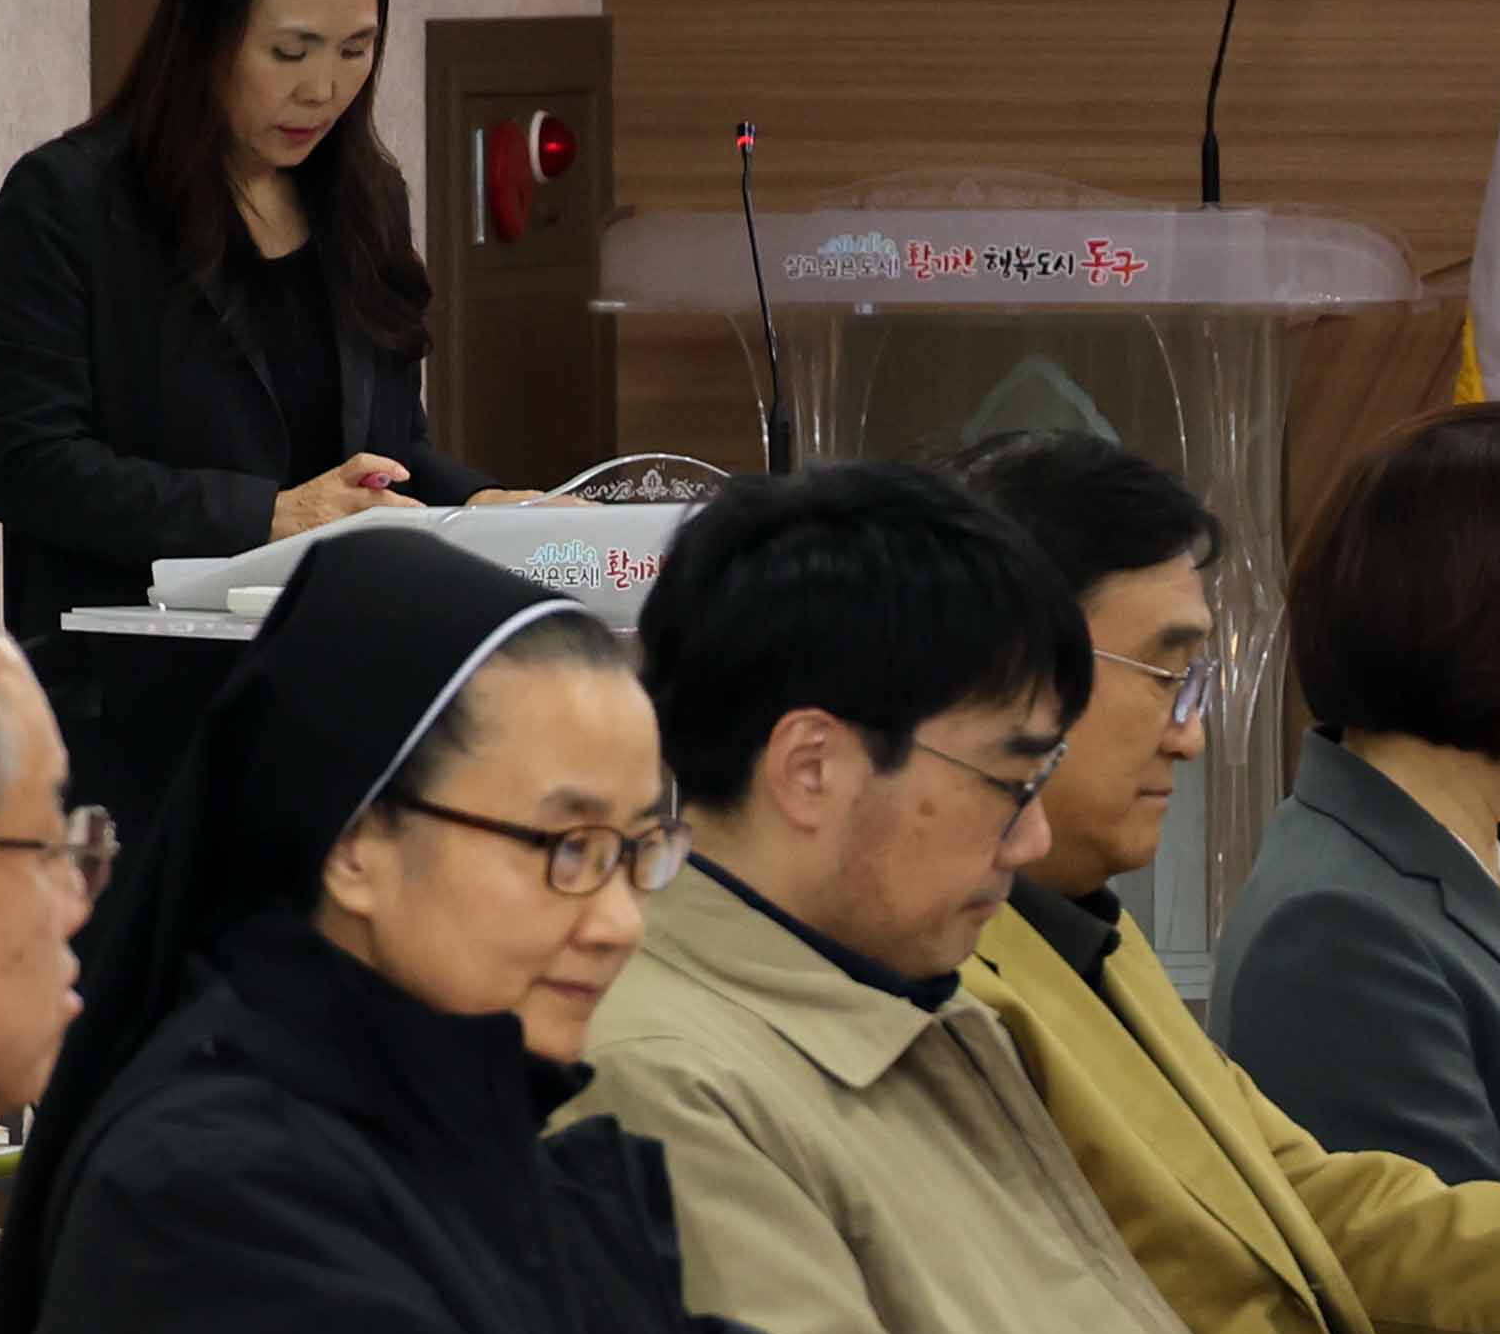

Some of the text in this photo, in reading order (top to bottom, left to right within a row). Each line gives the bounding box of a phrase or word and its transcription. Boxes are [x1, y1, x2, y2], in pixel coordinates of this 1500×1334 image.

[906, 240, 977, 280] 활기찬
[984, 245, 1074, 282] 행복도시
[1080, 238, 1147, 285] 동구
